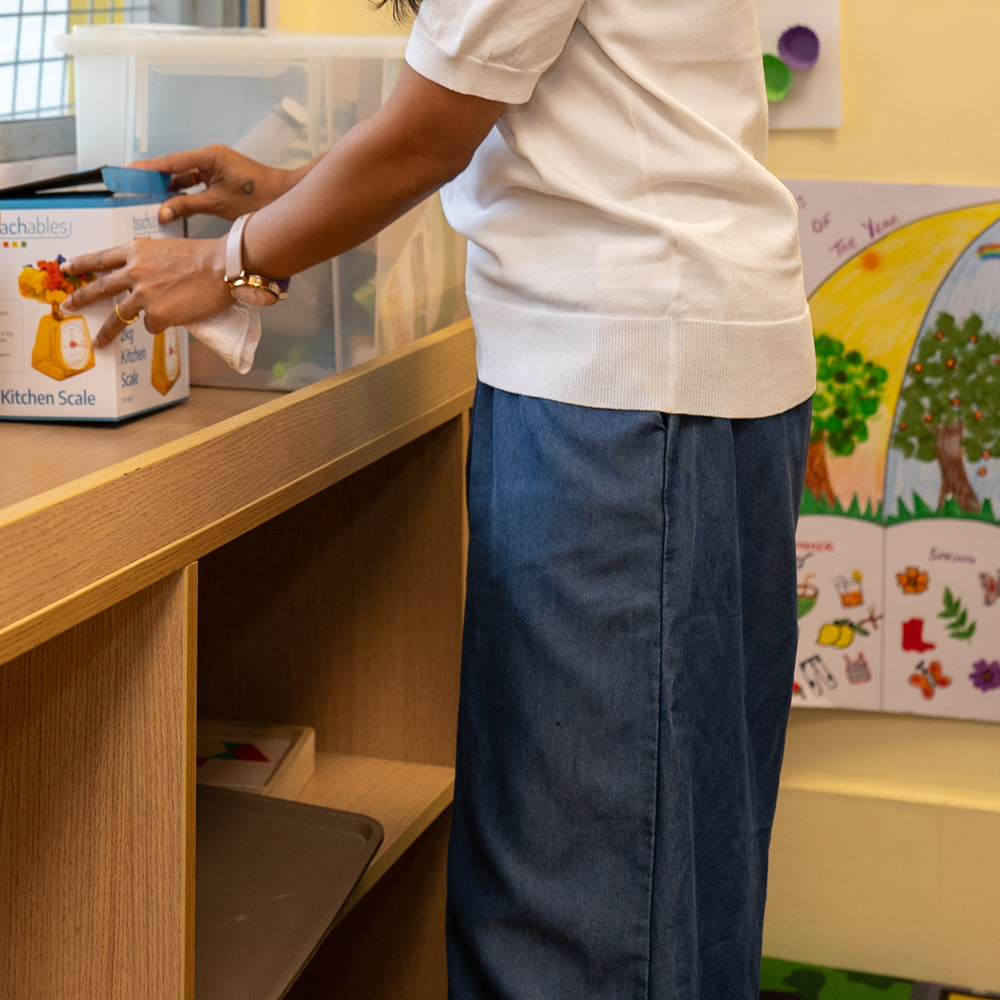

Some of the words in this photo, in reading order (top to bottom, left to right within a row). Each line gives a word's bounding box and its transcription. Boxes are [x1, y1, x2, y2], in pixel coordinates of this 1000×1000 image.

[121, 346, 147, 364] Kitchen
[1, 389, 54, 406] Kitchen
[58, 389, 96, 406] Scale
